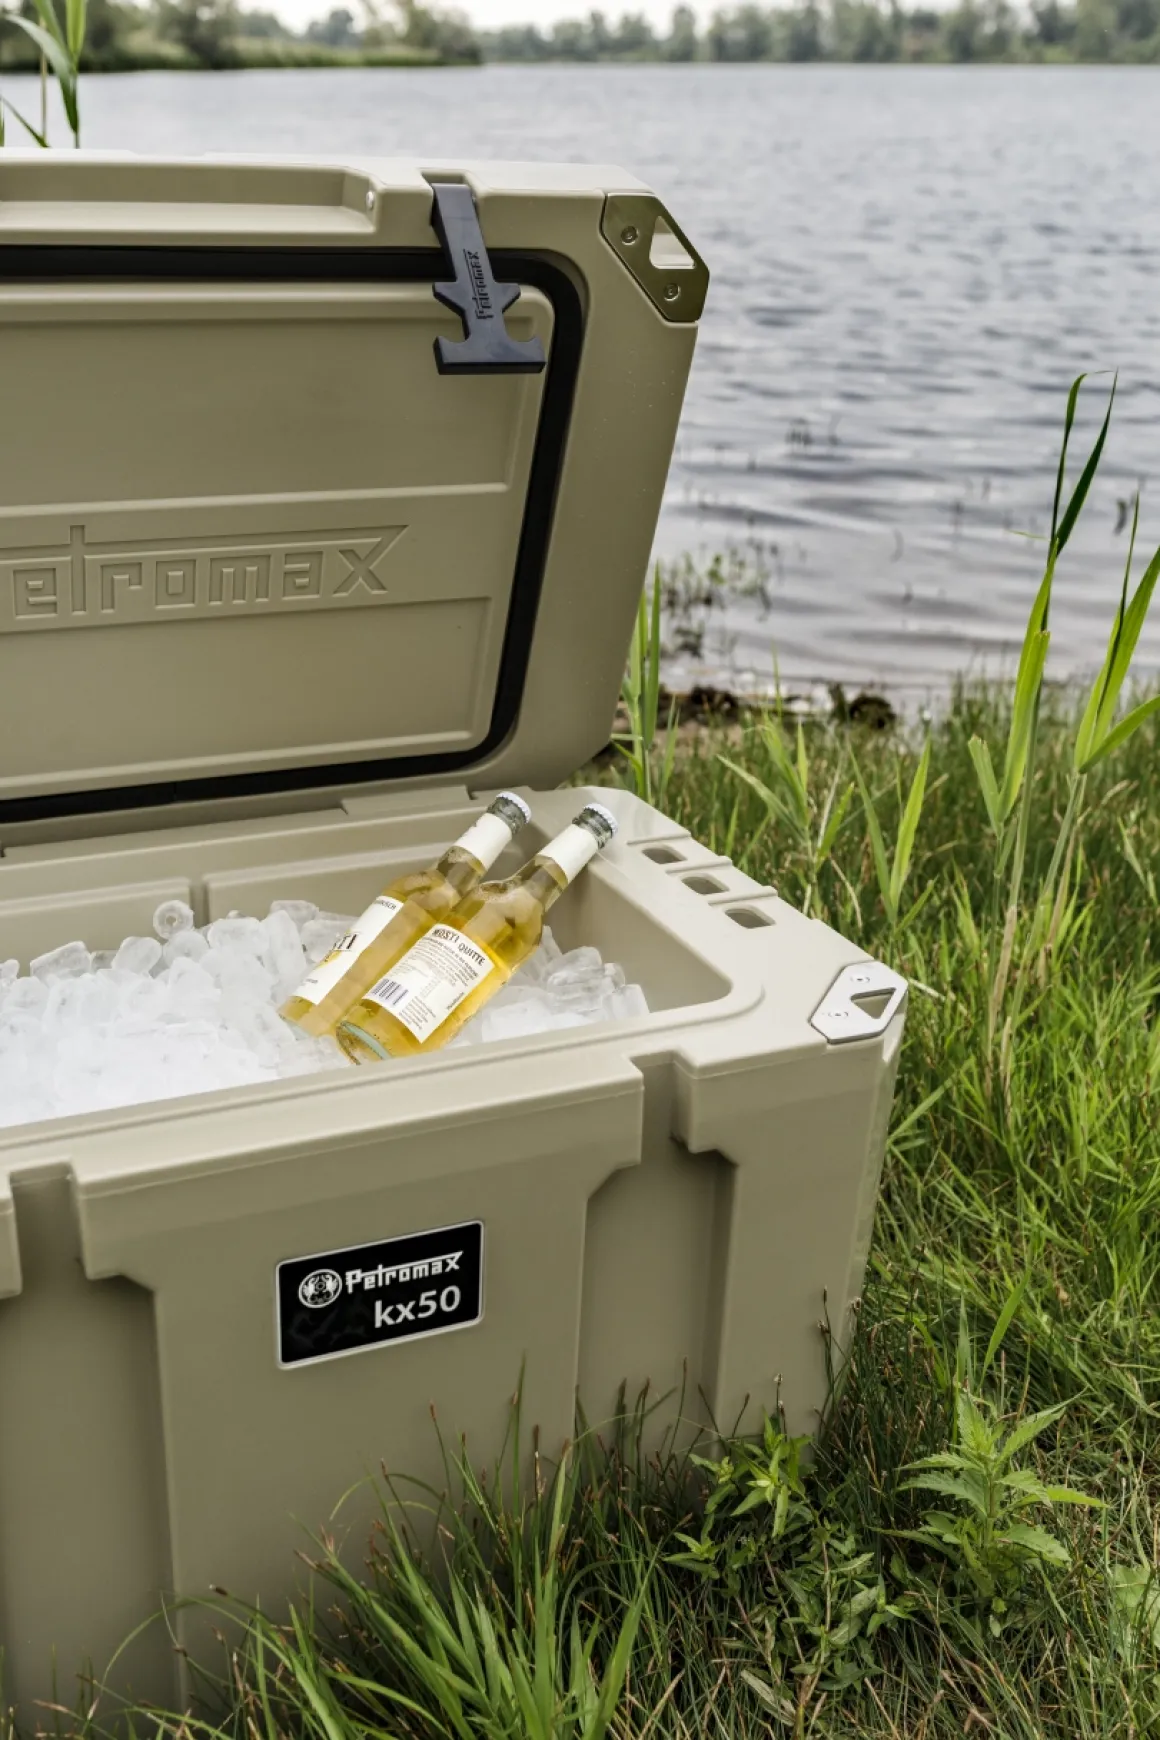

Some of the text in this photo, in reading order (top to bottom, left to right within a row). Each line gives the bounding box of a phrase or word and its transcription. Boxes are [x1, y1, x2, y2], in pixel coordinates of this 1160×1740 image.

[0, 525, 409, 620] etromax
[457, 942, 486, 967] QUITTE
[345, 1251, 463, 1294] Petromax
[374, 1285, 461, 1329] kx50
